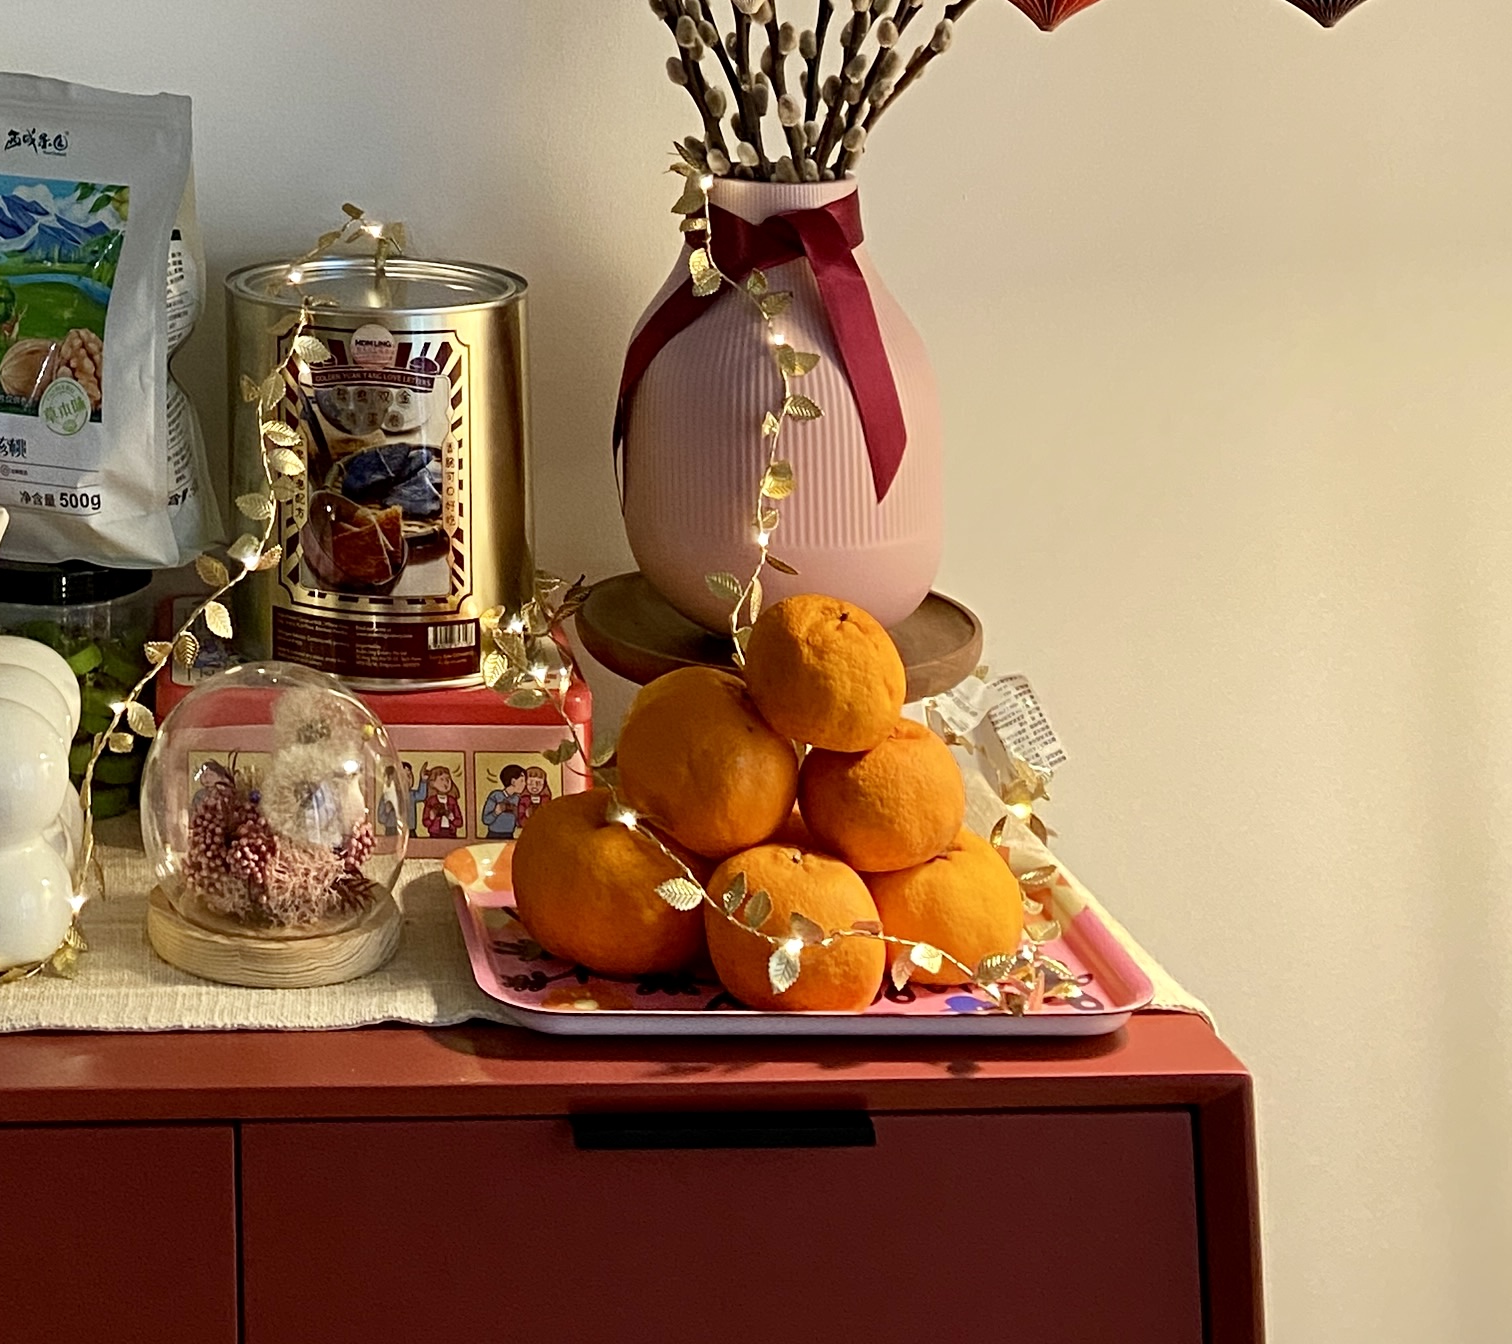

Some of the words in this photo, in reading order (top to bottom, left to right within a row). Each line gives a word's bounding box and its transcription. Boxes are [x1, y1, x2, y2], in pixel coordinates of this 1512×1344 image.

[315, 373, 341, 382] GOLDEN
[383, 373, 402, 382] LOVE
[402, 375, 432, 387] LETTERS
[19, 491, 56, 508] 净含量
[59, 492, 102, 510] 500g
